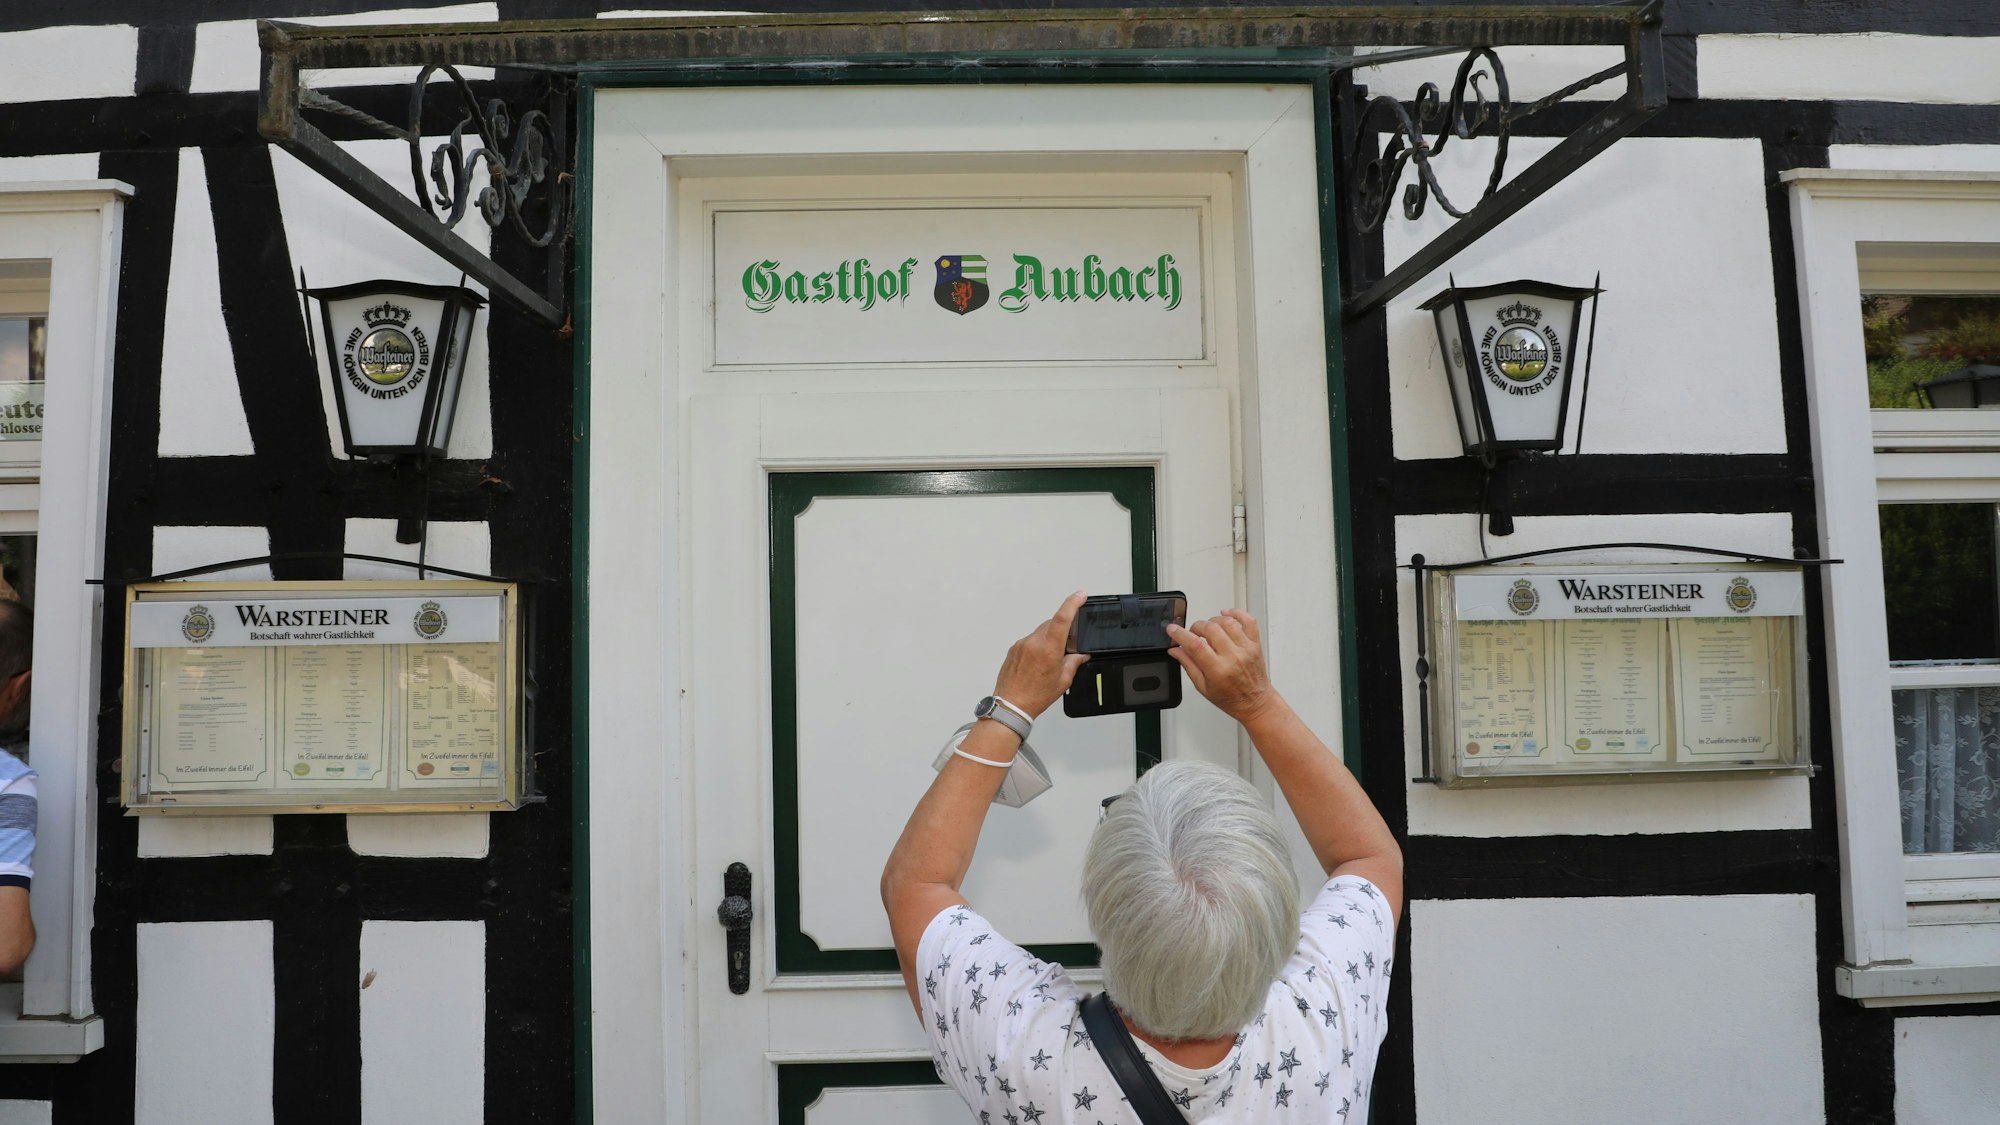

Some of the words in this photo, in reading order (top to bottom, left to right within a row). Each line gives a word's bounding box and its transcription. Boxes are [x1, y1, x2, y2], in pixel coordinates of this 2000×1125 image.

[742, 257, 919, 313] Gasthof
[998, 253, 1182, 313] Aubach
[344, 327, 363, 352] EINE
[411, 326, 429, 366] BIEREN
[1481, 326, 1498, 350] EINE
[1542, 325, 1562, 363] BIEREN
[359, 340, 415, 374] Warsteiner
[1495, 338, 1548, 371] Warsteiner
[343, 353, 371, 395] KÖNIGIN
[407, 368, 426, 390] DEN
[1481, 351, 1508, 391] KÖNIGIN
[1542, 365, 1559, 386] DEN
[371, 385, 408, 400] UNTER
[1508, 382, 1544, 396] UNTER
[1574, 604, 1613, 614] Botschaft
[1615, 604, 1643, 613] wahrer
[1643, 603, 1692, 613] Gastlichkeit
[250, 631, 291, 641] Botschaft
[293, 631, 322, 641] wahrer
[323, 630, 375, 640] Gastlichkeit
[305, 752, 327, 760] Zweifel
[429, 752, 451, 760] Zweifel
